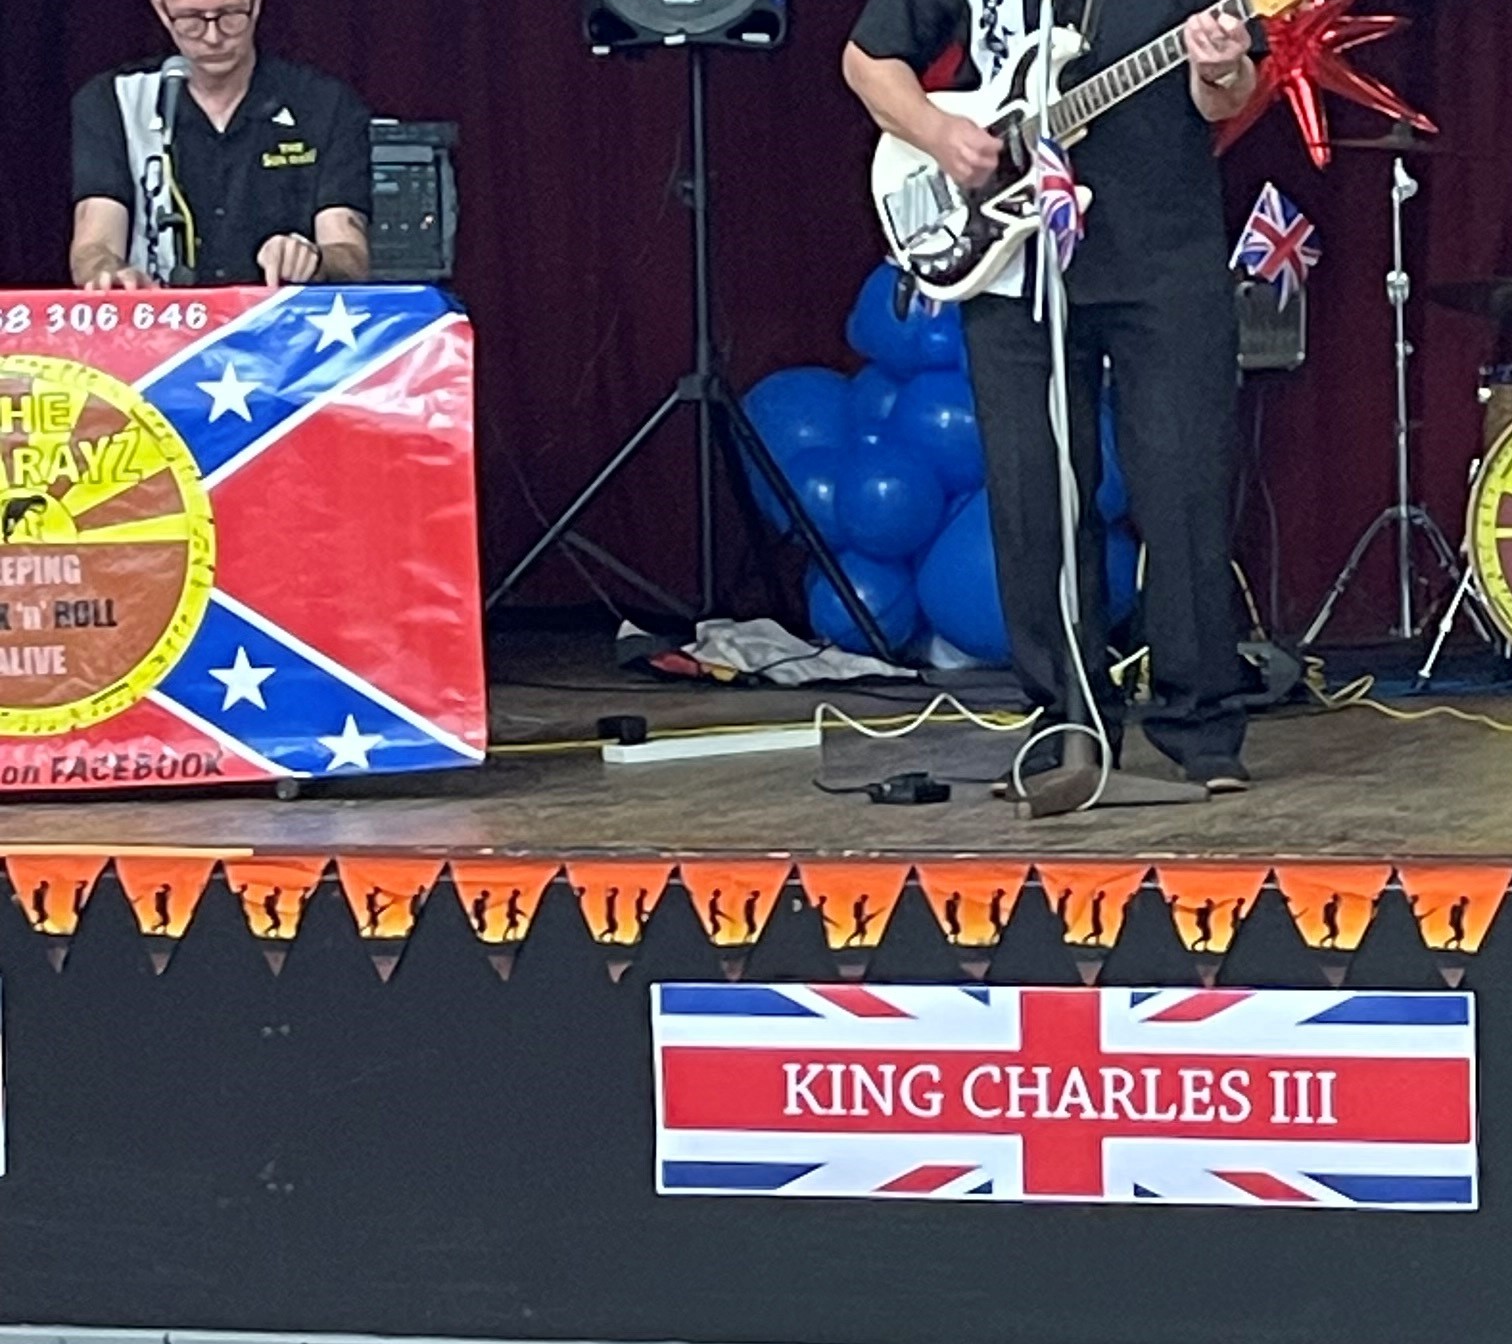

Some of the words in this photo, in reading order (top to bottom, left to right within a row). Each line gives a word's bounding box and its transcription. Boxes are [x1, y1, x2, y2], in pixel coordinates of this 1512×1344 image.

[0, 304, 32, 334] 8
[47, 303, 119, 334] 306
[132, 302, 208, 330] 646
[12, 427, 143, 487] RAYZ
[0, 555, 82, 585] EPING
[54, 598, 118, 629] ROLL
[2, 765, 40, 785] on
[51, 752, 224, 784] FACEBOOK
[783, 1062, 943, 1119] KING
[961, 1065, 1253, 1124] CHARLES
[1270, 1070, 1339, 1125] III
